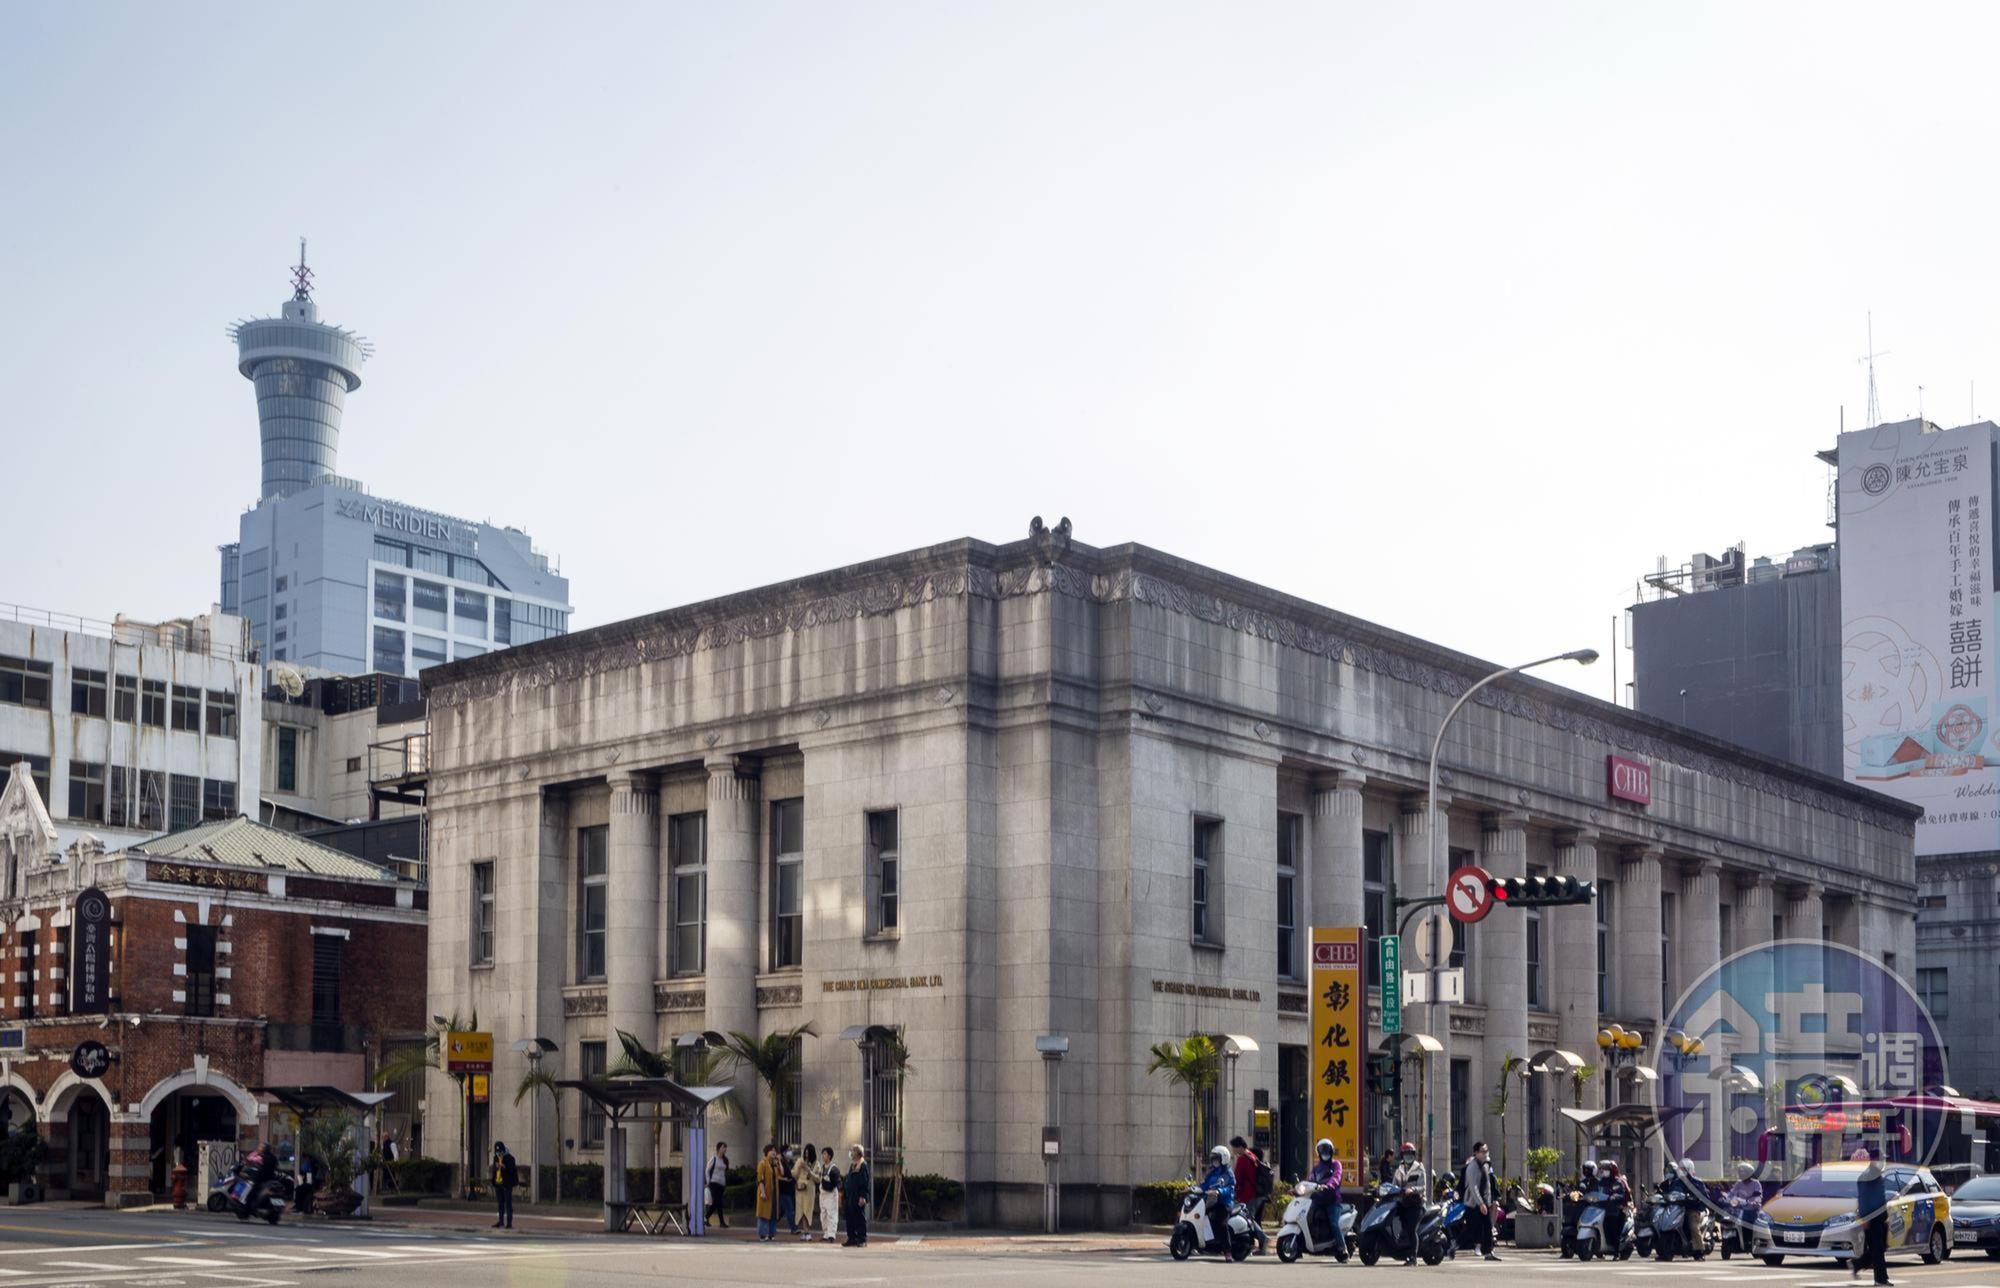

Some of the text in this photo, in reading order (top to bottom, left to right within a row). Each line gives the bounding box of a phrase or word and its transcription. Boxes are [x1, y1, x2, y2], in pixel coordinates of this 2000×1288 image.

[1896, 454, 1969, 483] 陳允宝泉
[1948, 499, 1962, 617] 傳承百年手工婚嫁
[1614, 763, 1649, 796] CHB
[1315, 944, 1356, 961] CHB
[1385, 946, 1395, 1009] 自由路二段
[1322, 980, 1351, 1128] 彰化銀行
